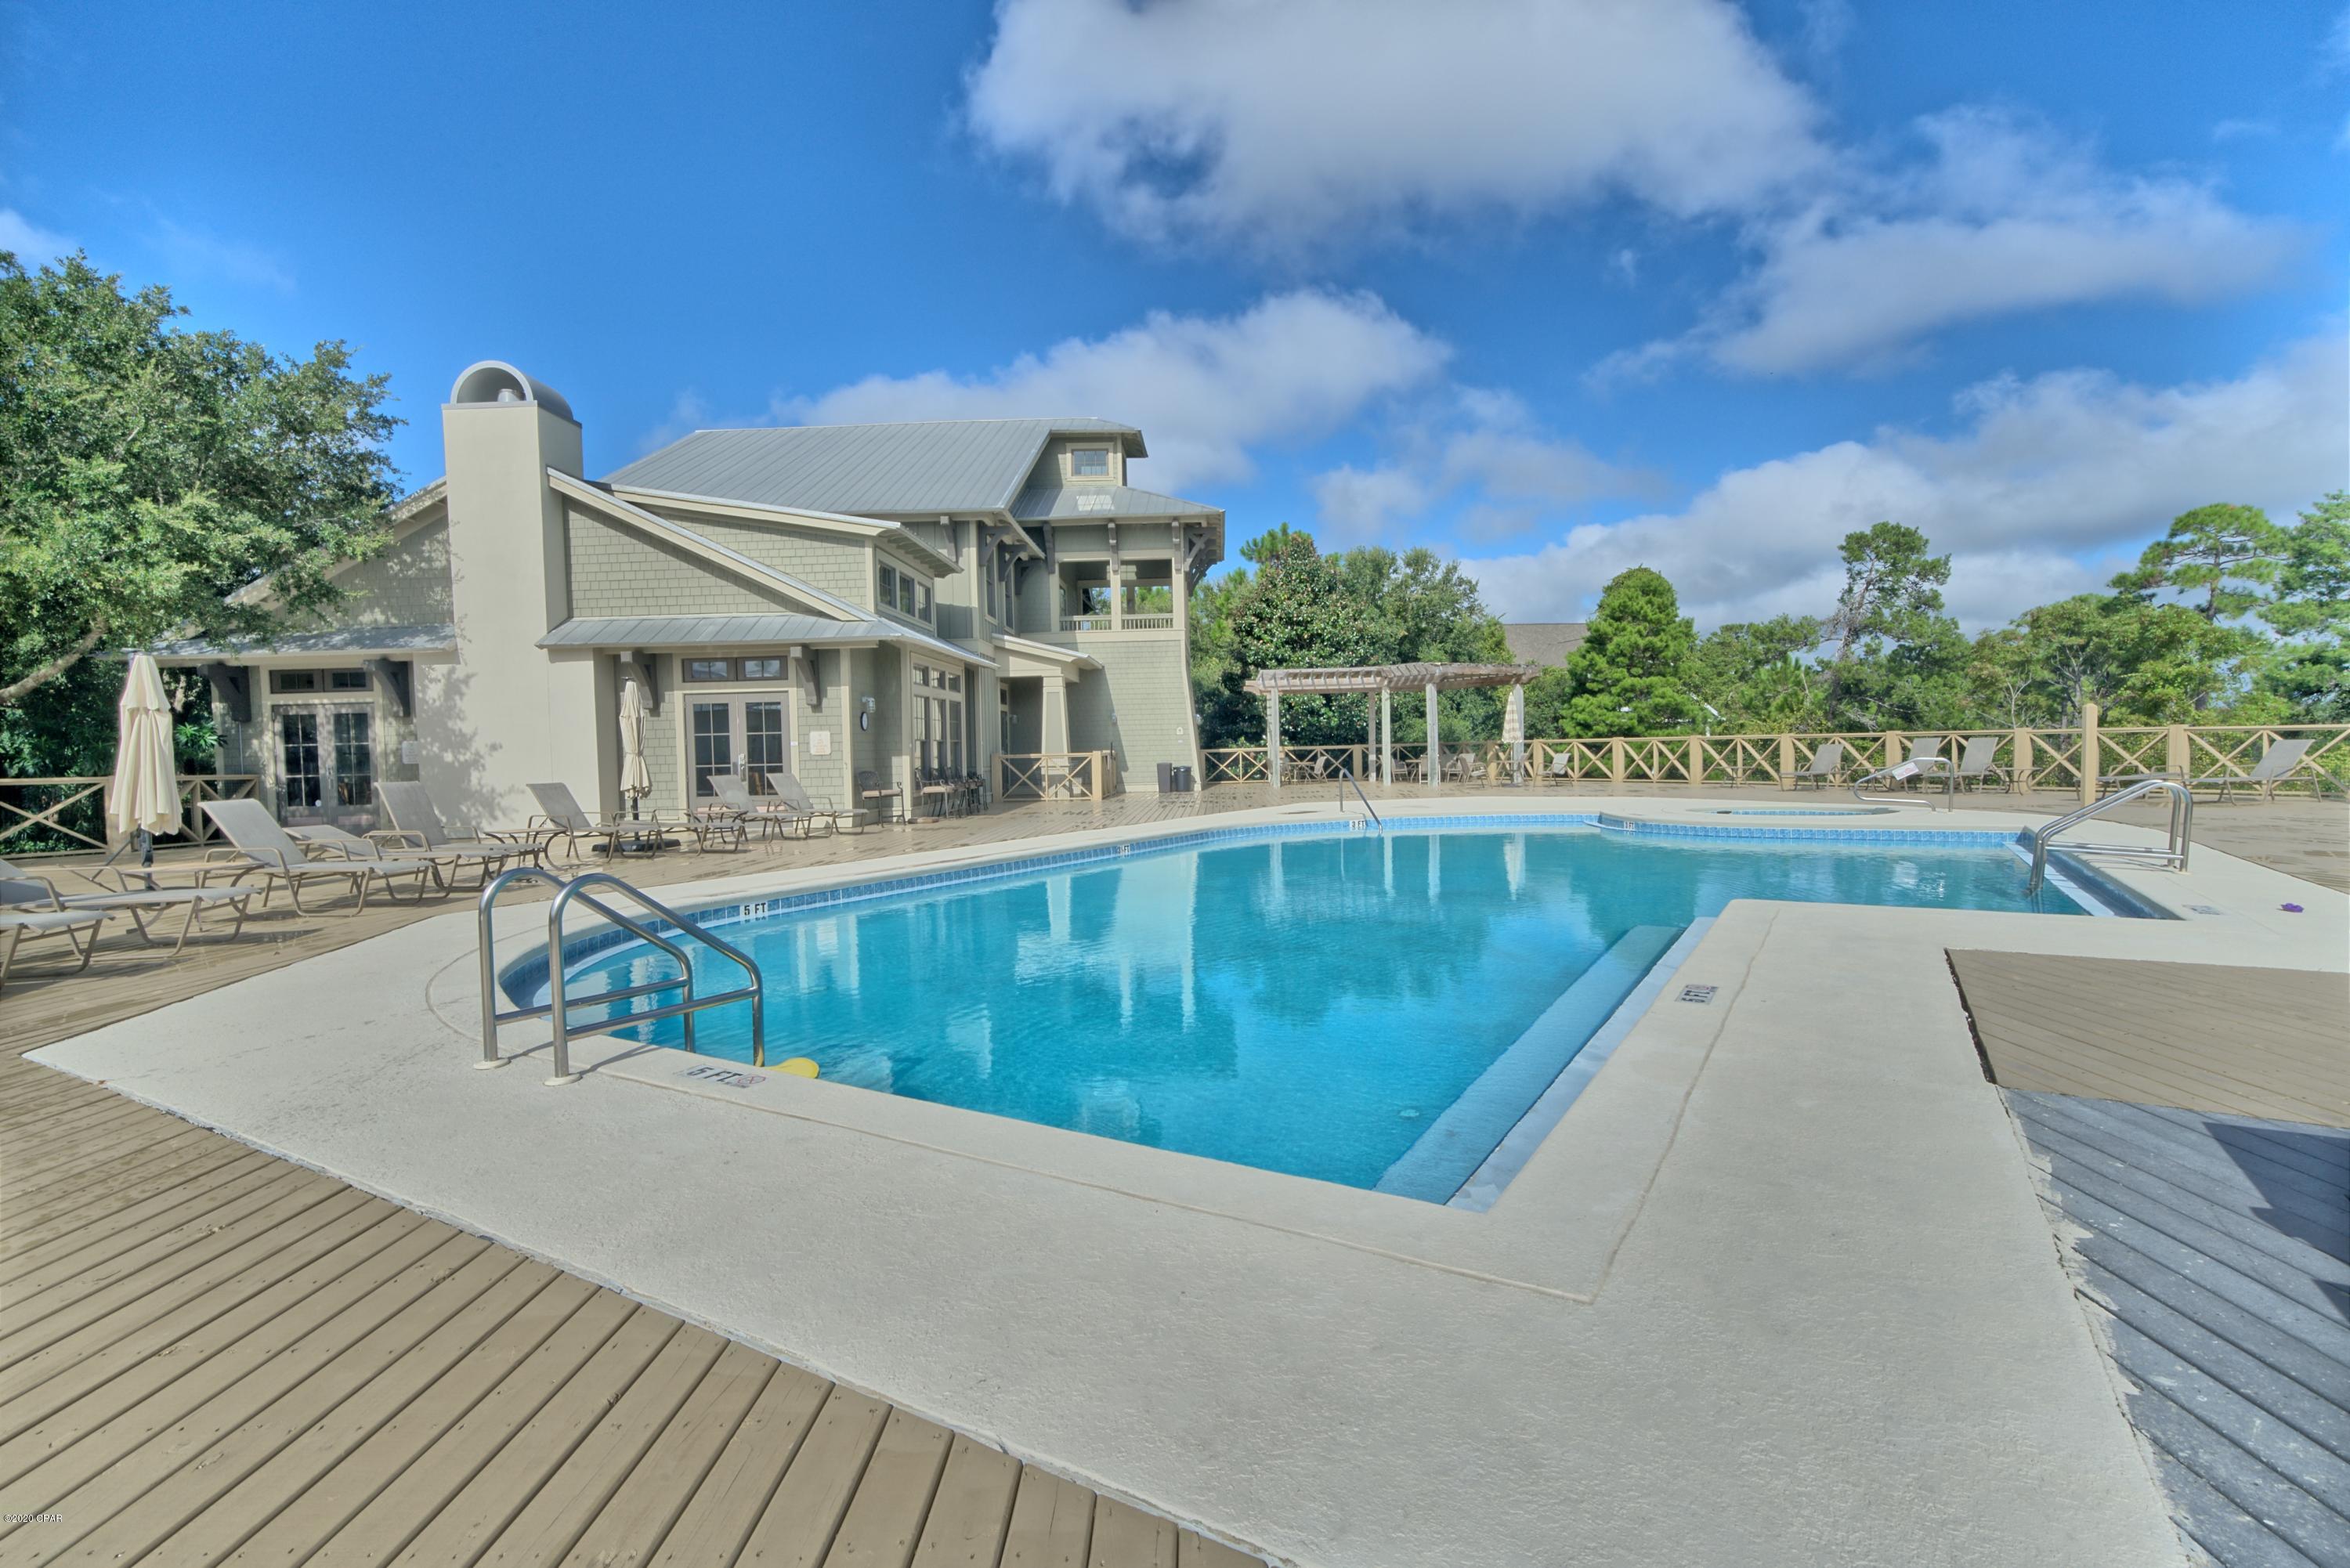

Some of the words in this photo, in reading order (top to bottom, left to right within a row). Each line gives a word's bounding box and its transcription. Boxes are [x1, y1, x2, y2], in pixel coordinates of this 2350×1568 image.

[743, 905, 750, 916] 5
[754, 901, 767, 915] FT
[687, 1066, 714, 1076] 5
[703, 1071, 744, 1082] FT
